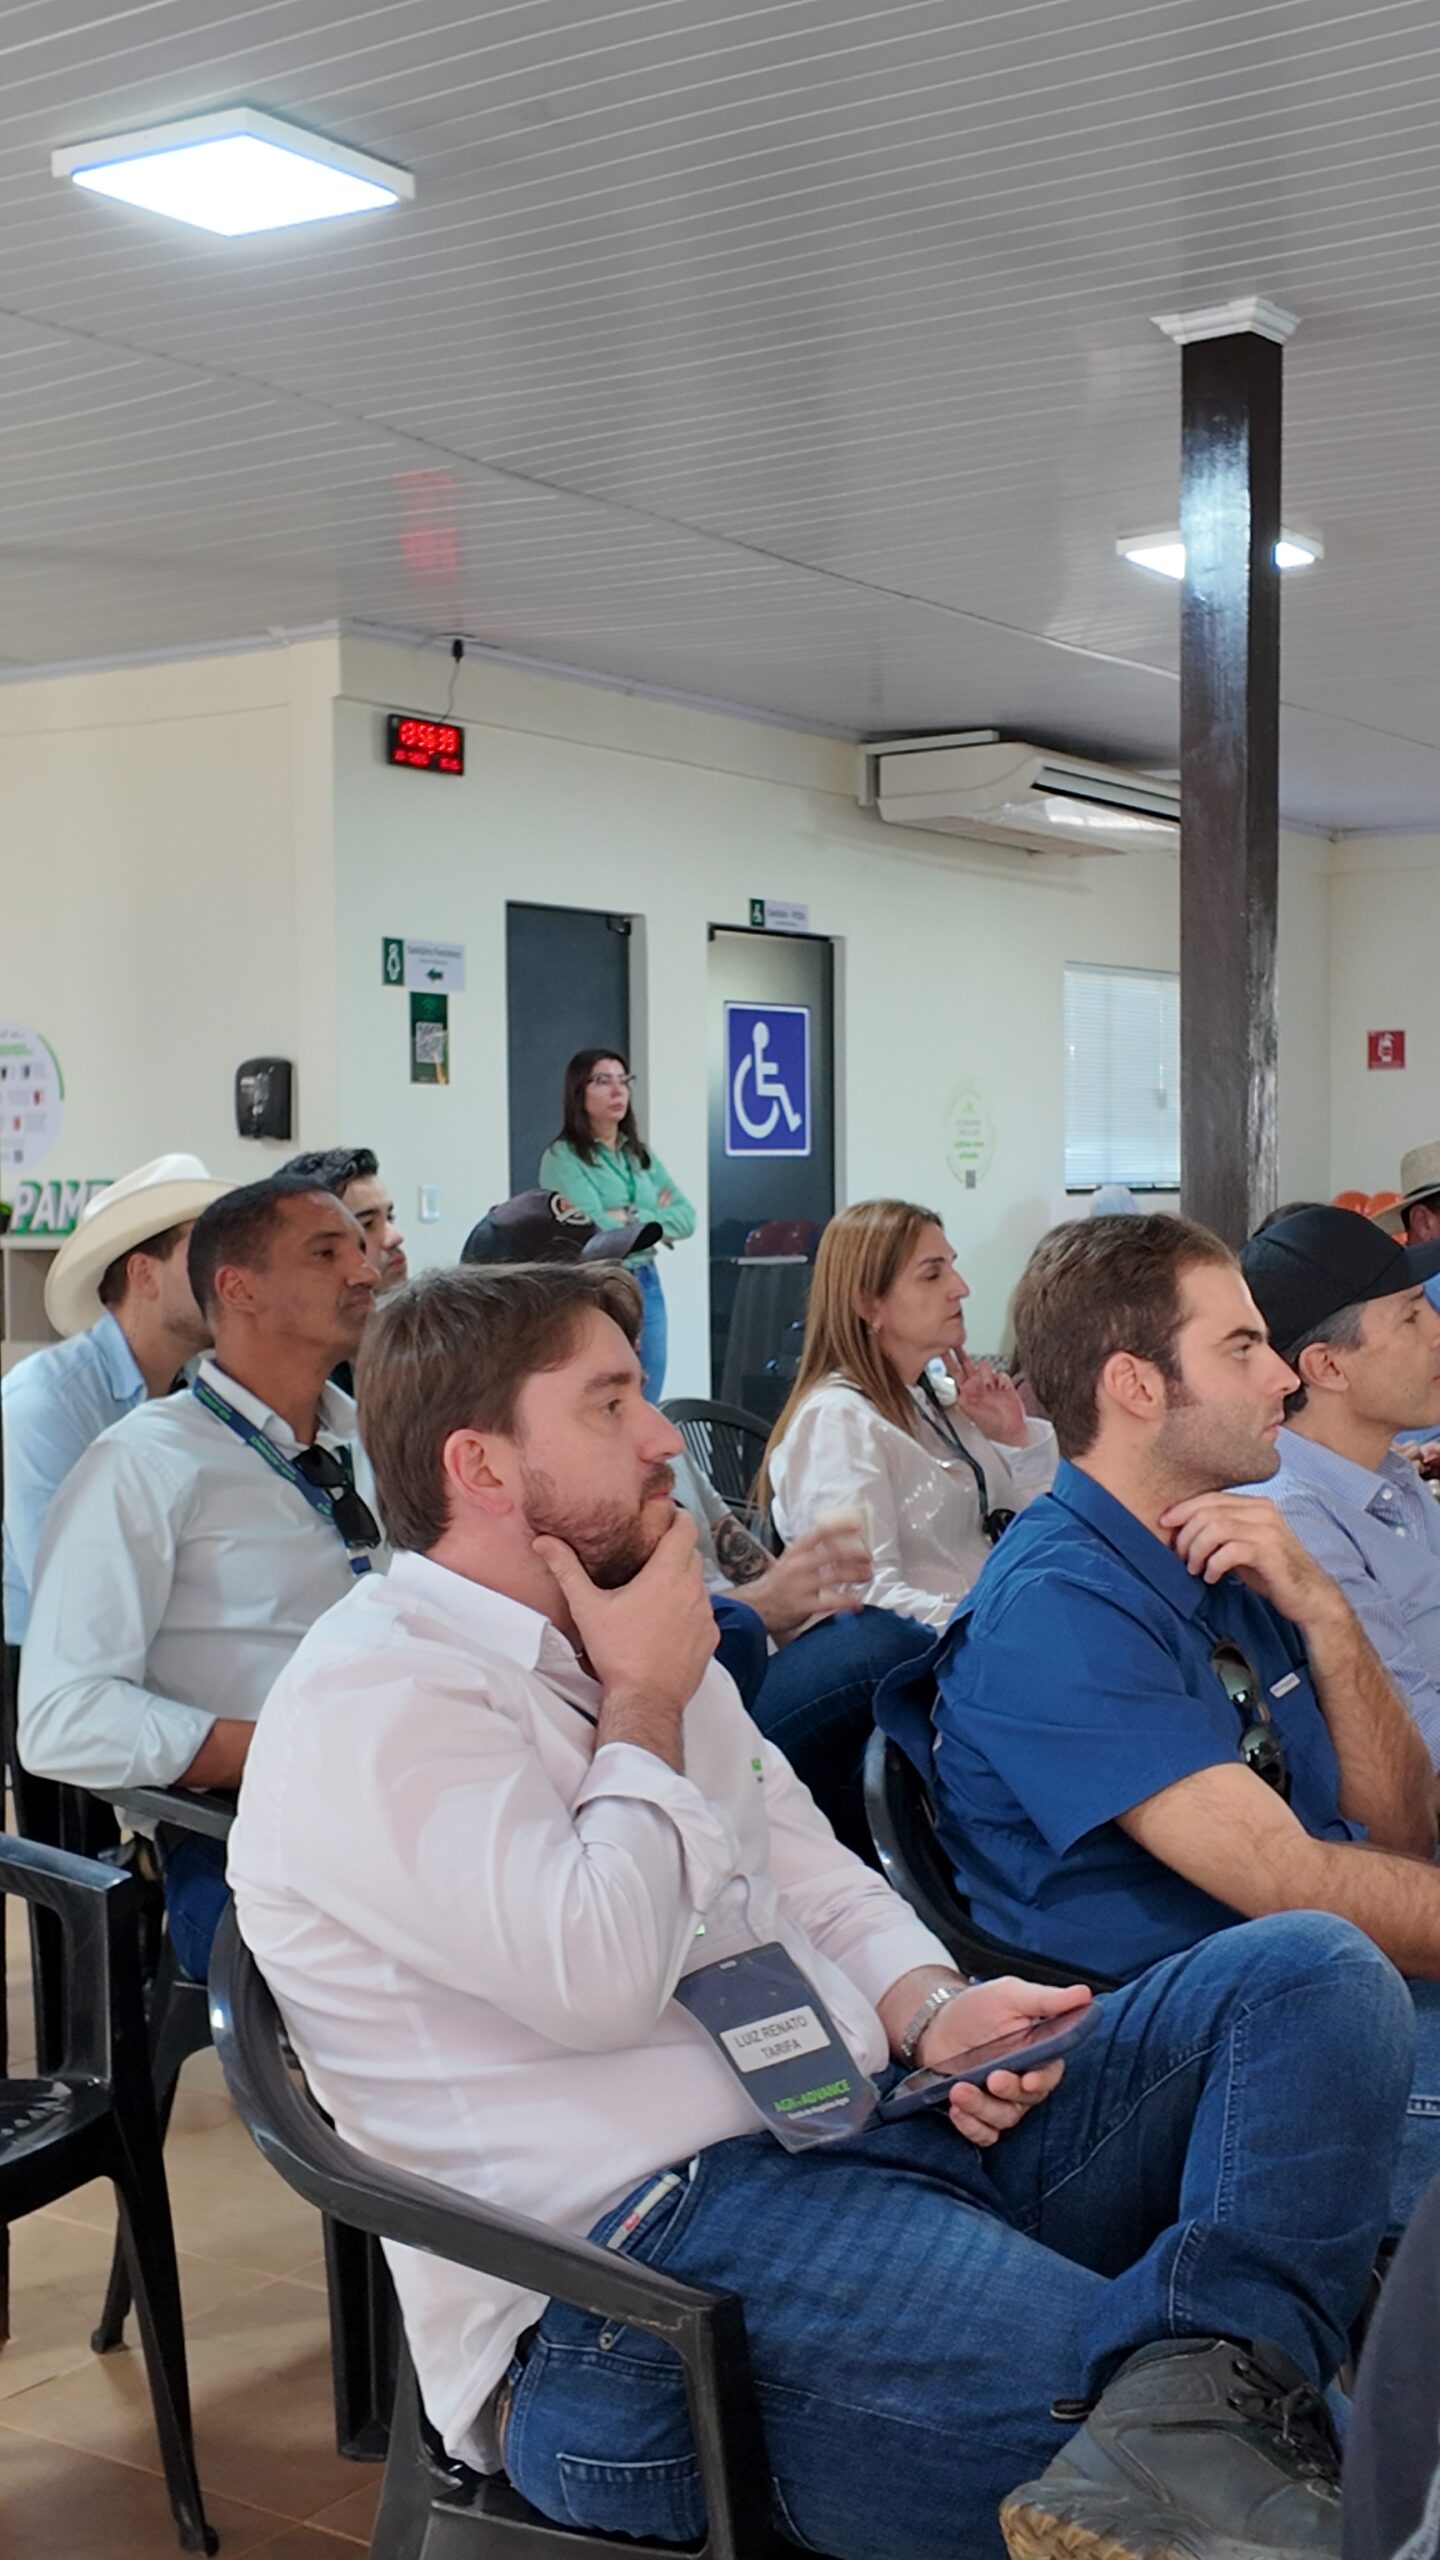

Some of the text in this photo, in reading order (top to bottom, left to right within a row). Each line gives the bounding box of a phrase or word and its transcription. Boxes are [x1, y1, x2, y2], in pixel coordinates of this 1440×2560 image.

[734, 2015, 808, 2048] LUIZ RENATO
[761, 2038, 802, 2059] TARIFA
